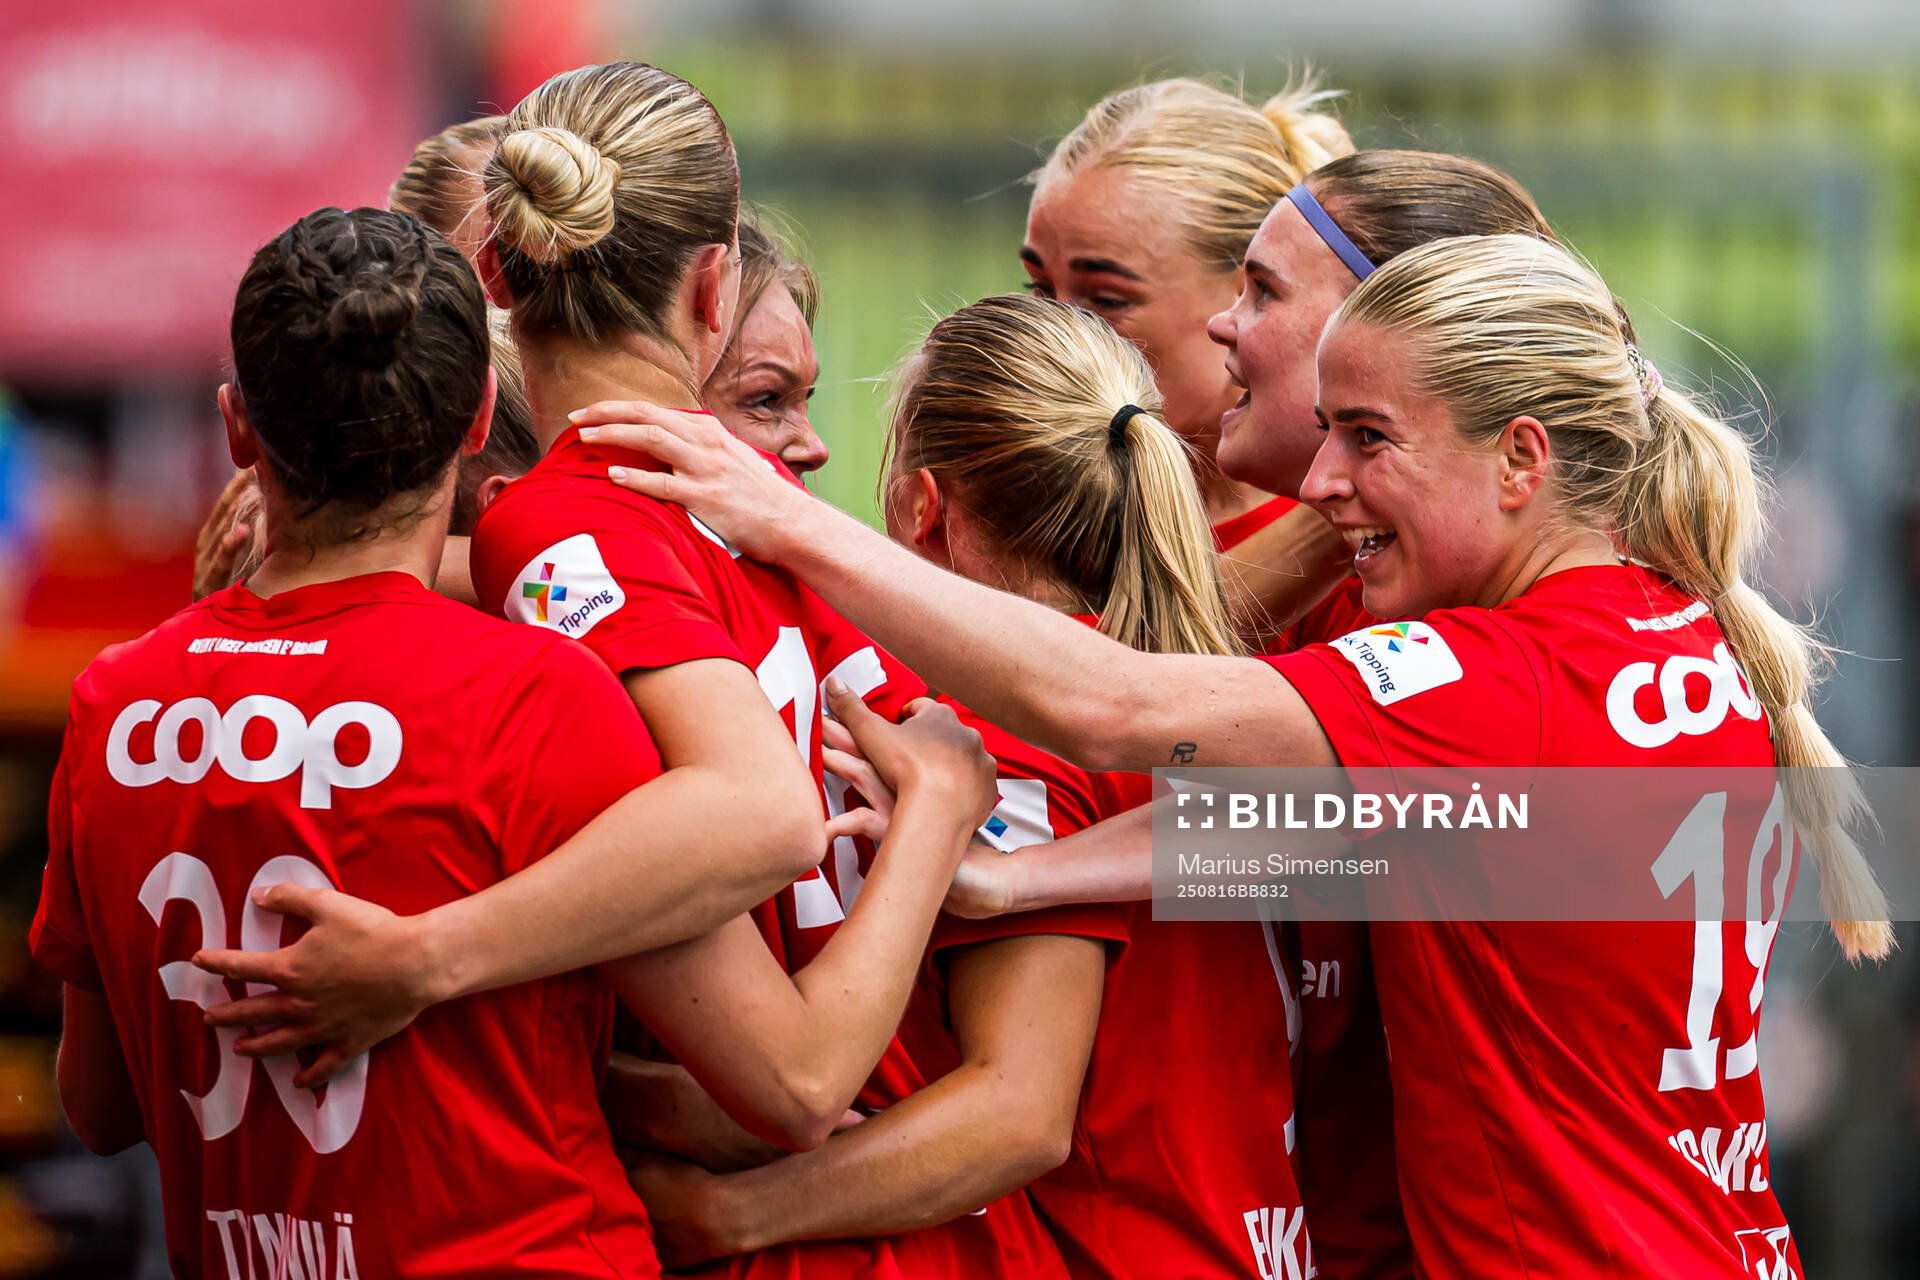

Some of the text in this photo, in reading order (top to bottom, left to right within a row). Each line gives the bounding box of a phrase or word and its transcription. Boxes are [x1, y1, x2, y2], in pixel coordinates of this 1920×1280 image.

[558, 589, 614, 633] Tipping
[1355, 641, 1396, 695] Tipping
[105, 694, 404, 810] coop
[1649, 779, 1795, 1093] 19
[137, 851, 371, 1155] 30
